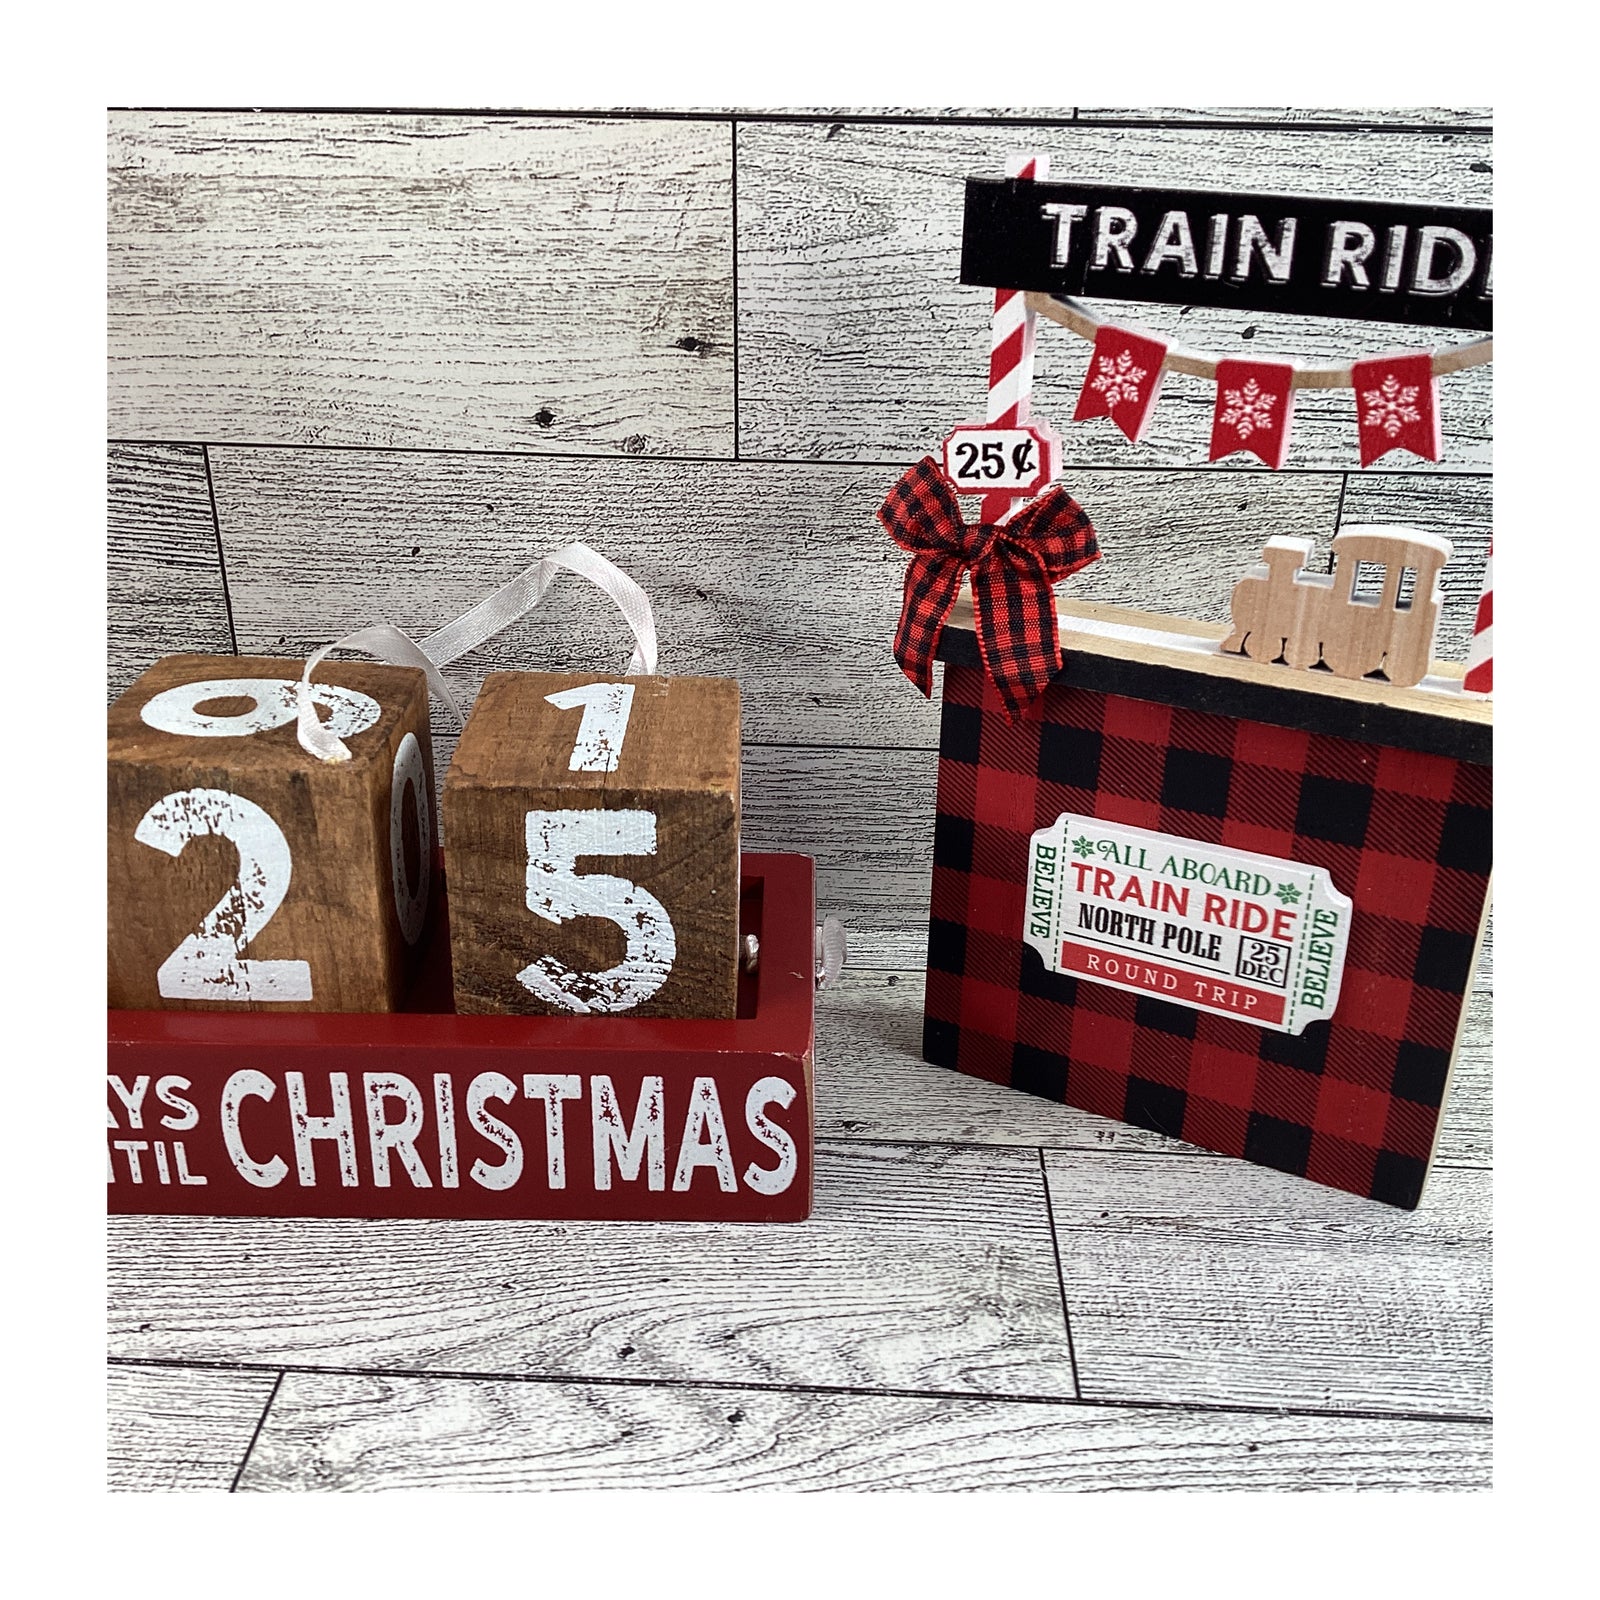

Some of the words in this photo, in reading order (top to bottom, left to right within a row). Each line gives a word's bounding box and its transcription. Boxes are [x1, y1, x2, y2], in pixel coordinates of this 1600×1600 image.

[1040, 201, 1299, 286] TRAIN
[1320, 220, 1492, 300] RID
[543, 682, 636, 773] 1
[1030, 843, 1057, 939] BELIEVE
[1097, 839, 1153, 872] ALL
[1159, 855, 1272, 897] ABOARD
[1070, 861, 1190, 918] TRAIN
[1202, 892, 1298, 942] RIDE
[1078, 902, 1157, 946] NORTH
[1161, 922, 1222, 962] POLE
[1250, 941, 1280, 966] 25
[1300, 908, 1339, 1011] BELIEVE
[1086, 953, 1179, 991] ROUND
[1193, 981, 1259, 1011] TRIP
[1239, 962, 1285, 985] DEC
[107, 1074, 200, 1131] YS
[219, 1068, 798, 1196] CHRISTMAS
[107, 1140, 208, 1186] TIL
